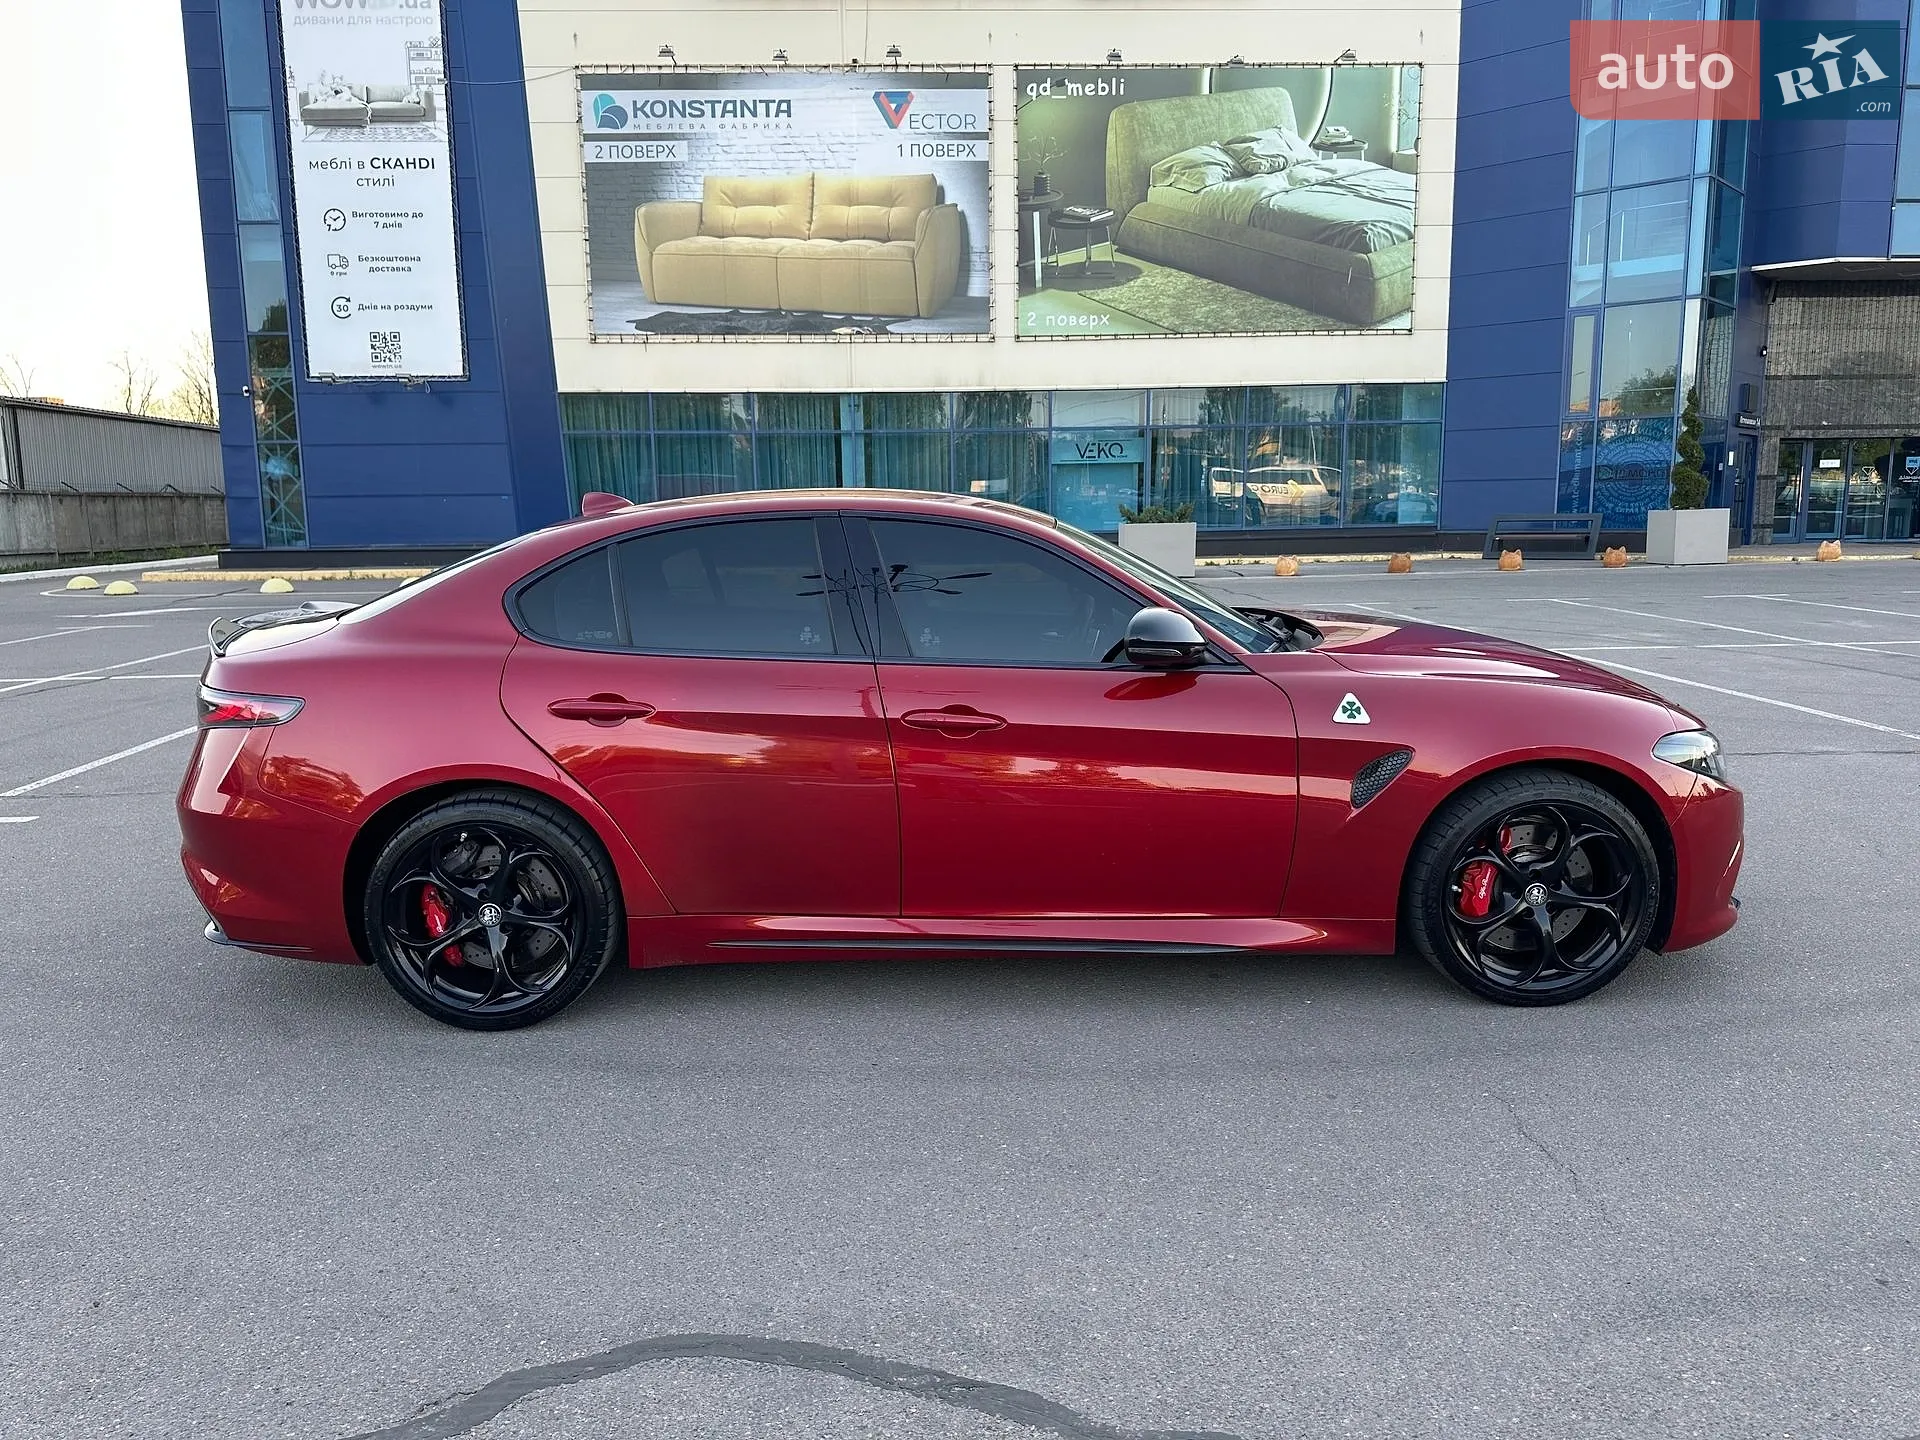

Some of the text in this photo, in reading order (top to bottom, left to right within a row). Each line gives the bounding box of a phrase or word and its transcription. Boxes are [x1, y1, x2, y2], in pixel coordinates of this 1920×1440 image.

[293, 15, 433, 27] дивани для настрою
[632, 99, 792, 119] KONSTANTA
[633, 122, 793, 130] МЕБЛЕВА ФАБРИКА
[595, 144, 677, 159] 2 ПОВЕРХ
[896, 143, 976, 158] 1 ПОВЕРХ
[308, 157, 352, 170] меблі
[357, 160, 365, 170] в
[356, 174, 396, 187] стилі
[351, 211, 424, 220] Виготовимо до
[373, 221, 403, 230] 7 днів
[357, 254, 421, 263] Безкоштовна
[368, 265, 412, 274] доставка
[336, 304, 349, 313] 30
[357, 303, 378, 311] Днів
[394, 304, 433, 313] роздуми
[1027, 311, 1110, 330] 2 поверх
